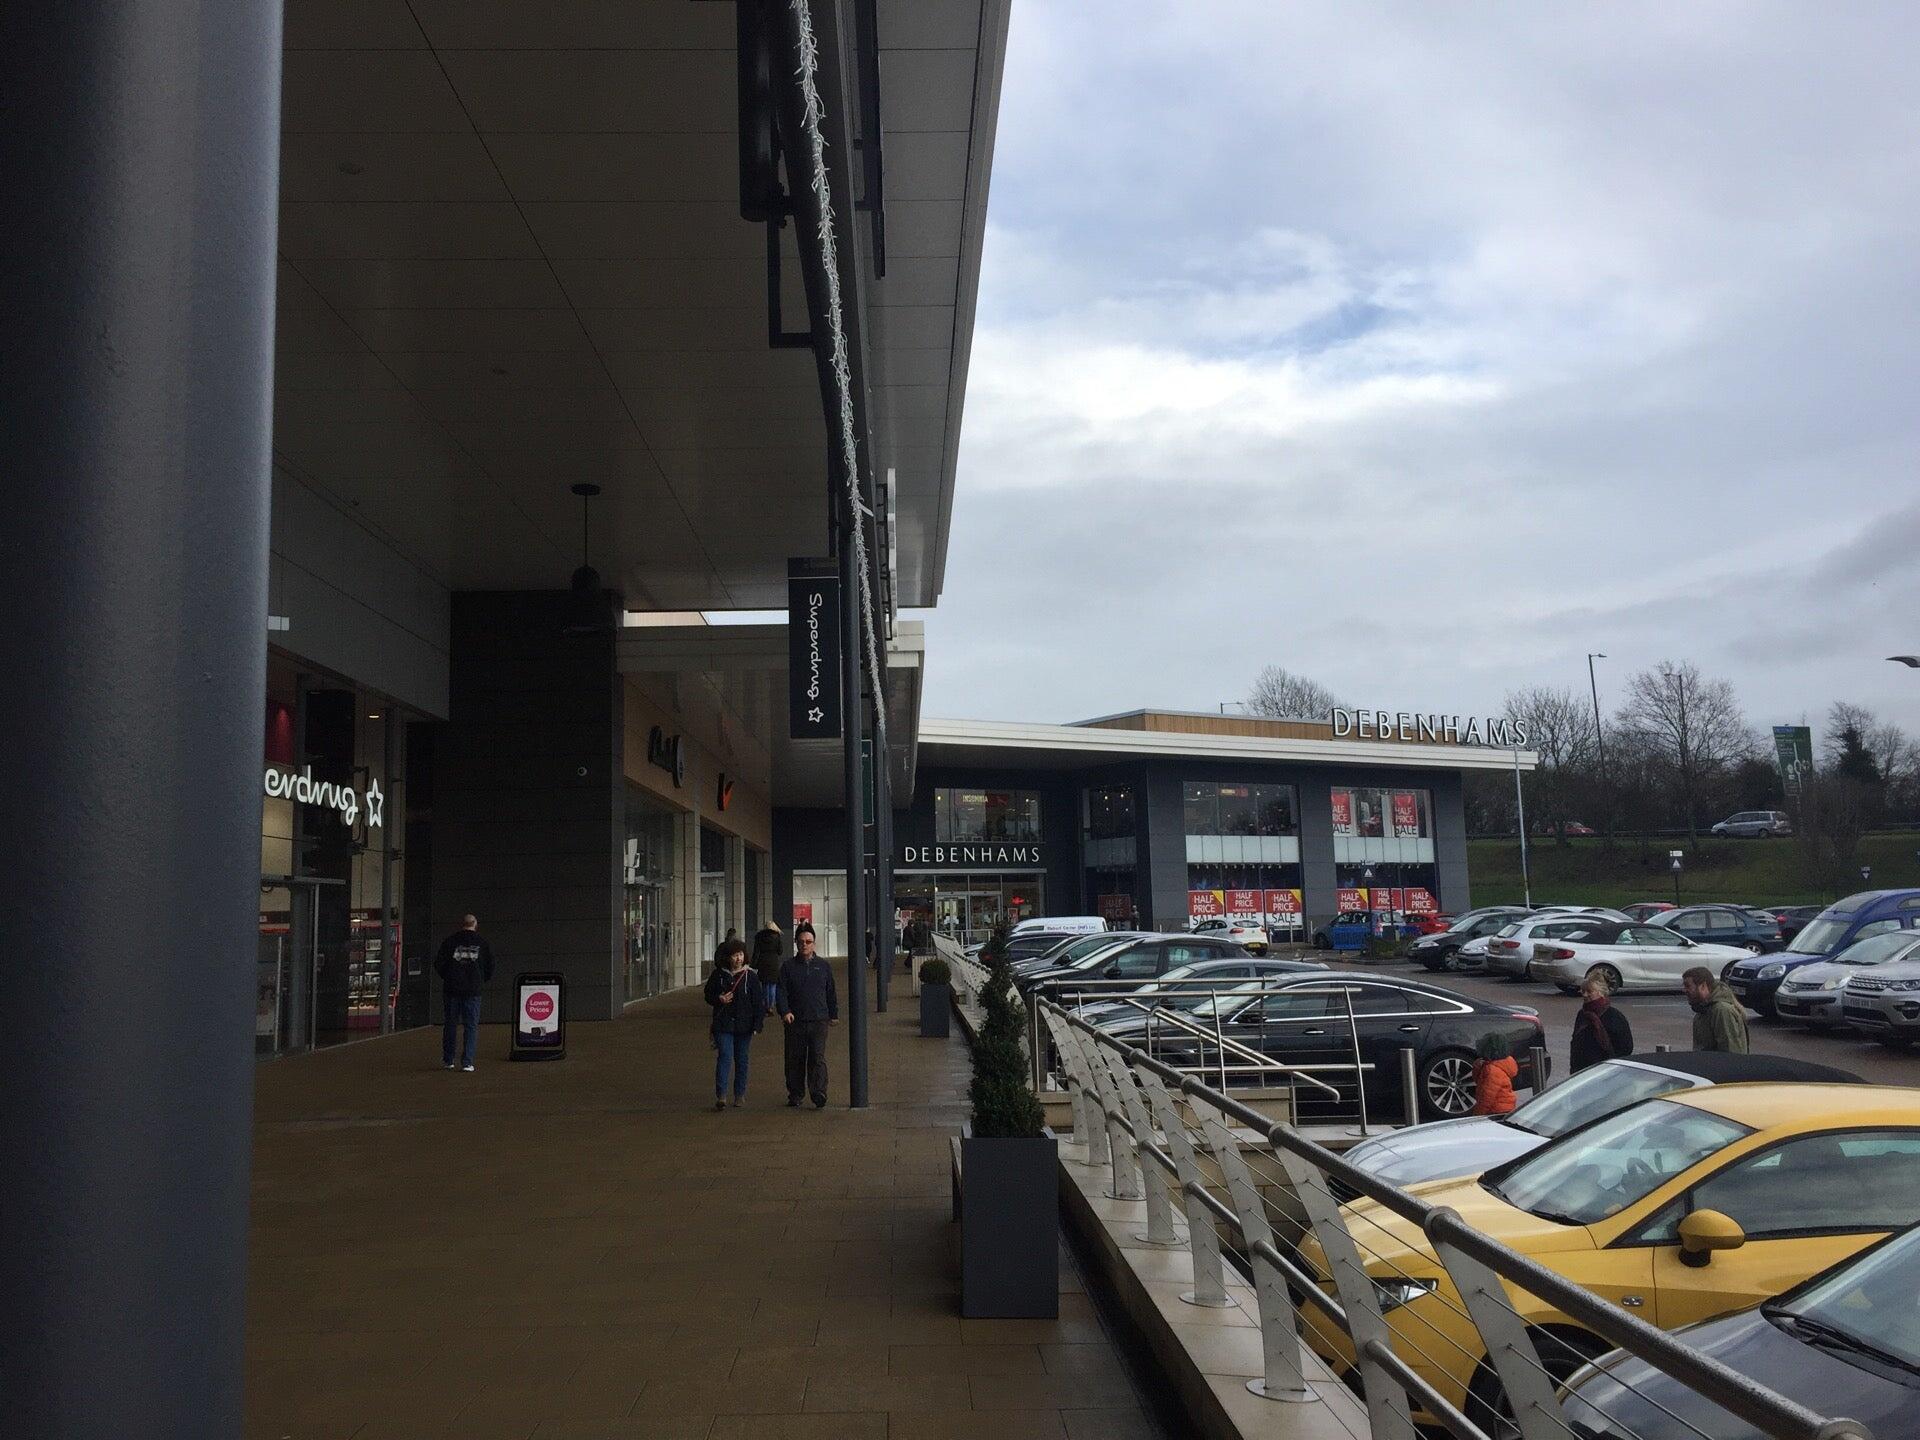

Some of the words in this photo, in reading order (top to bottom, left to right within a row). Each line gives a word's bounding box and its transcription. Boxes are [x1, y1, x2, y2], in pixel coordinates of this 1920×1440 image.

[806, 592, 823, 701] Superdrug
[1331, 707, 1528, 747] DEBENHAMS
[264, 764, 359, 826] erdrug
[1394, 807, 1412, 815] HALF
[1395, 815, 1414, 823] PRICE
[904, 846, 1040, 863] DEBENHAMS
[1194, 895, 1214, 904] HALF
[1235, 892, 1253, 900] HALF
[1273, 893, 1293, 902] HALF
[1341, 893, 1360, 901] HALF
[1411, 892, 1429, 900] HALF
[1234, 899, 1254, 907] PRICE
[1273, 903, 1294, 912] PRICE
[1340, 901, 1361, 910] PRICE
[1411, 900, 1432, 909] PRICE
[1193, 904, 1216, 913] PRICE
[1273, 913, 1295, 924] SALE
